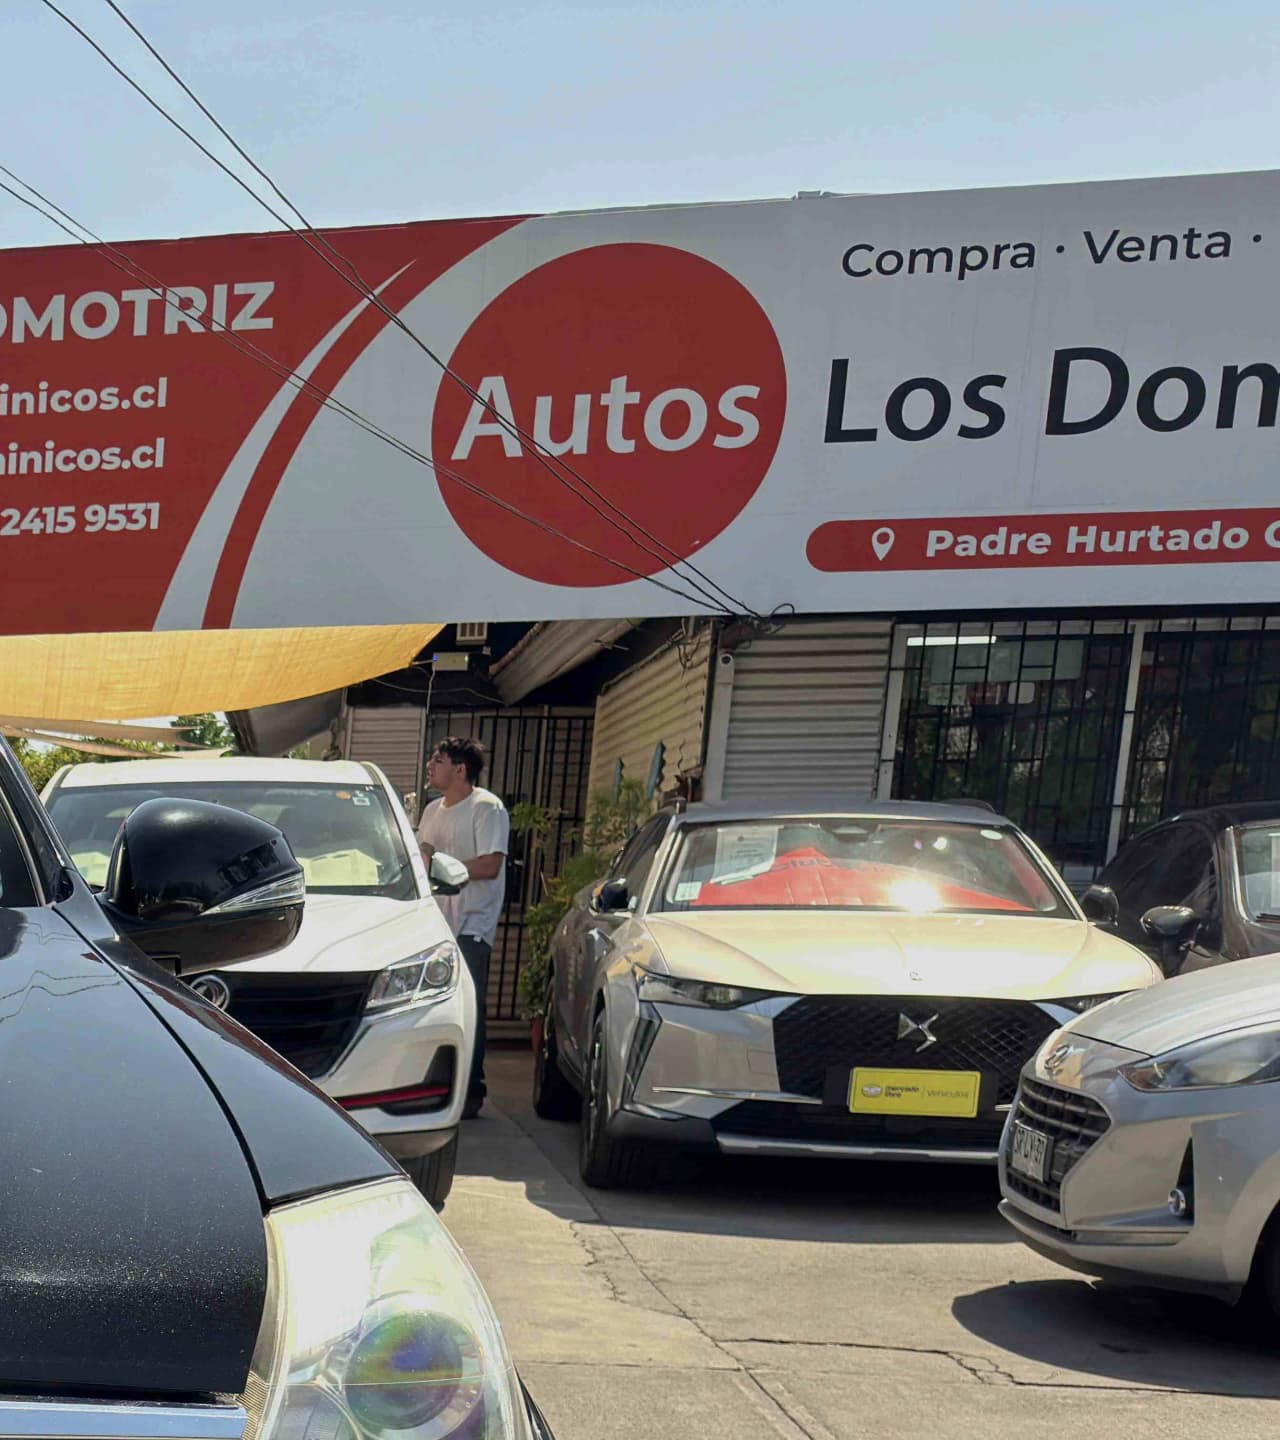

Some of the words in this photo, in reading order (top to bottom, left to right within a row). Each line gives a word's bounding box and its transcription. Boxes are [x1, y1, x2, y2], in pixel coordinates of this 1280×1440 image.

[841, 242, 1036, 280] Compra
[1083, 228, 1233, 265] Venta
[451, 373, 762, 461] Autos
[823, 358, 1008, 444] Los
[0, 505, 77, 536] 2415
[83, 502, 160, 533] 9531
[926, 525, 1052, 558] Padre
[1065, 519, 1250, 555] Hurtado
